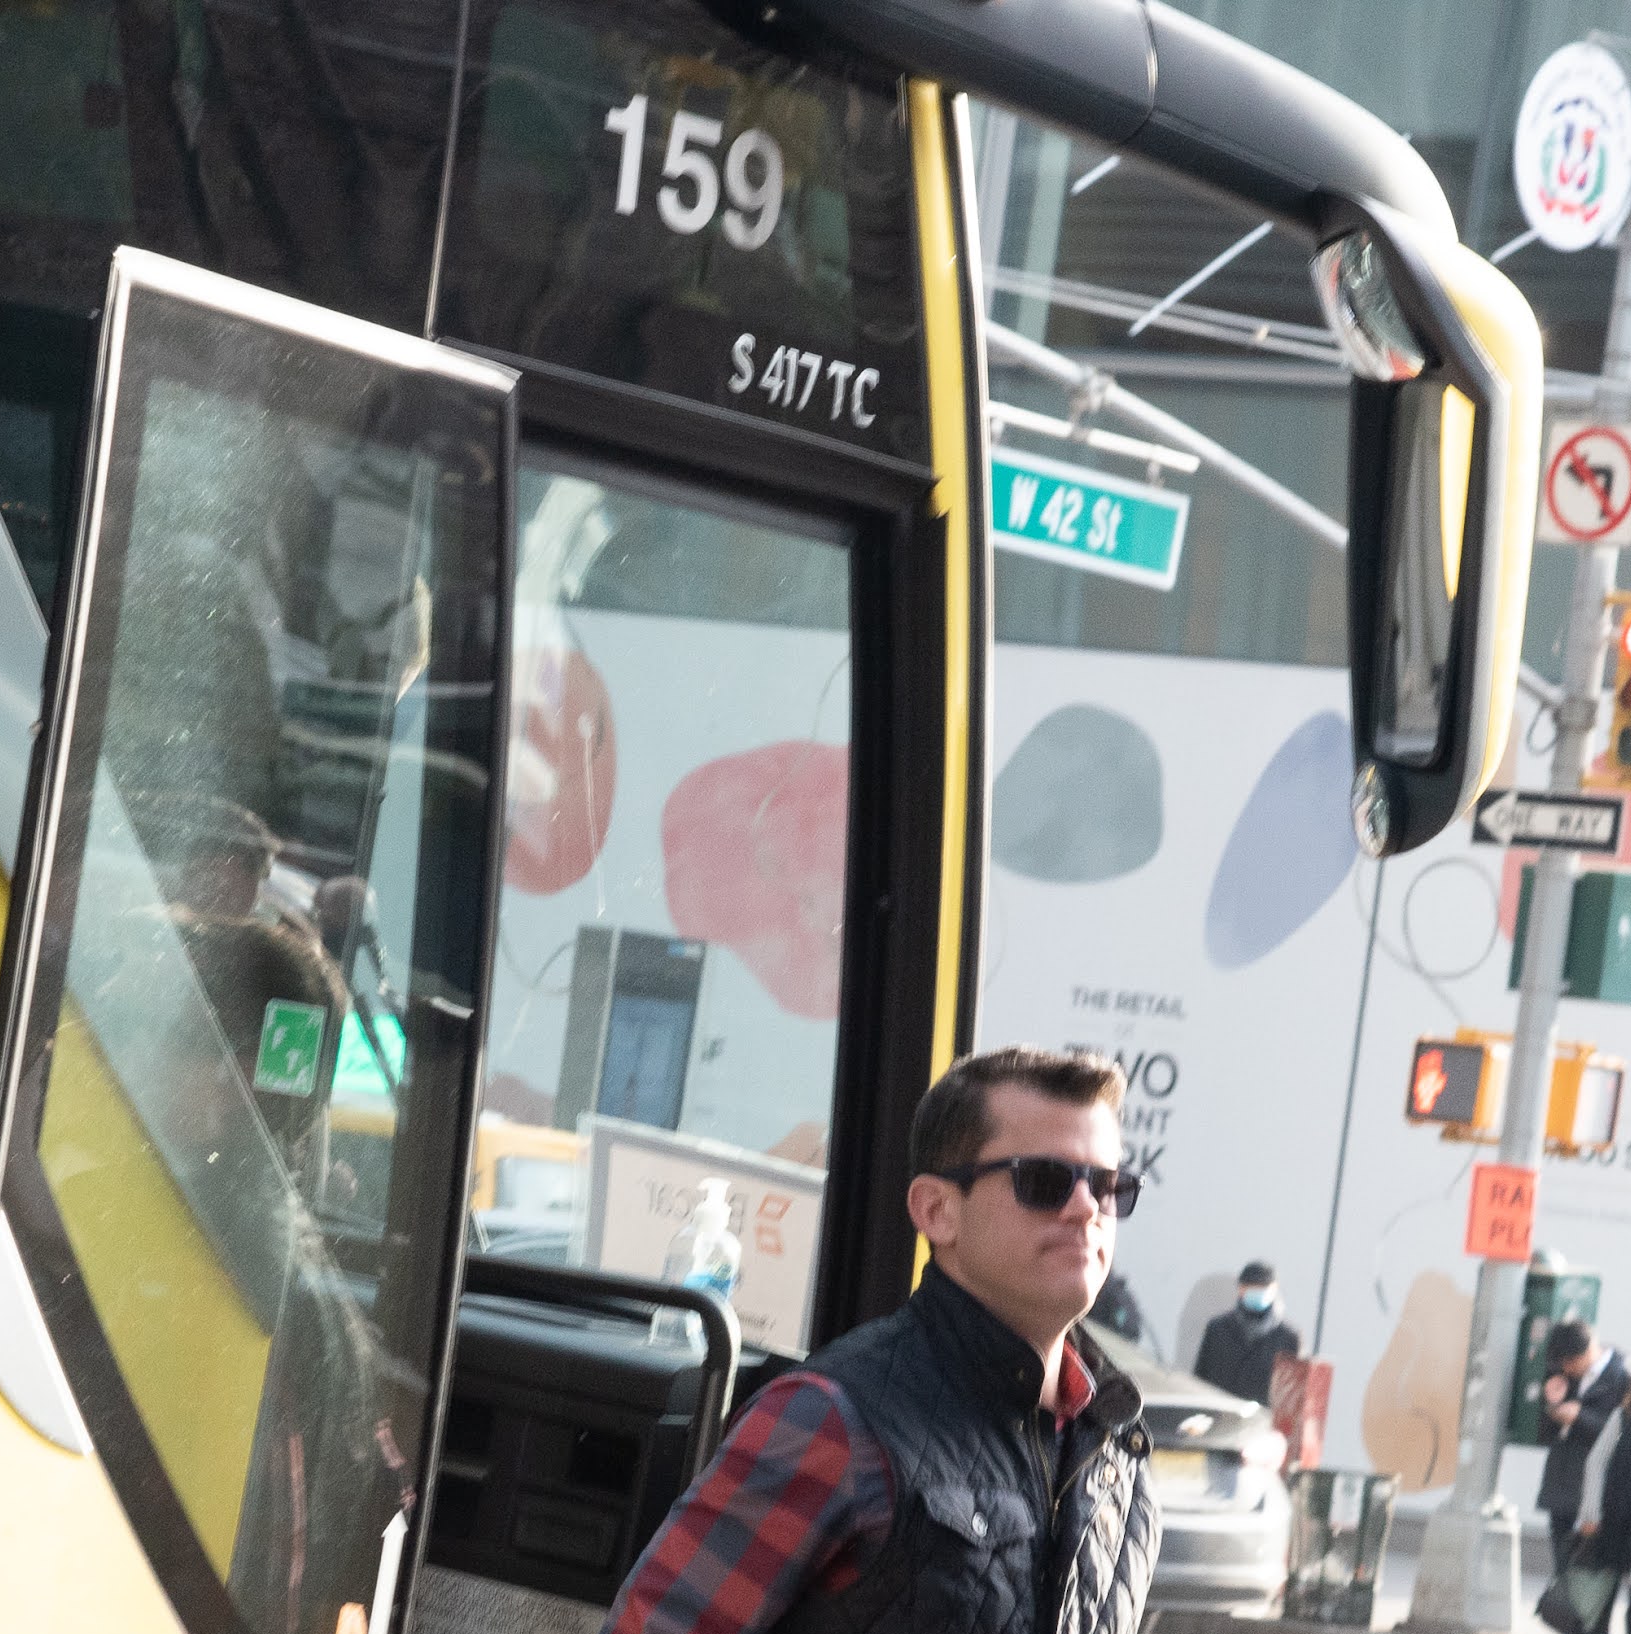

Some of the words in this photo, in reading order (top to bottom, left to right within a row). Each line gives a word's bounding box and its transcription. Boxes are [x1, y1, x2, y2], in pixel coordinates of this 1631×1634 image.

[604, 93, 784, 251] 159
[726, 332, 757, 394] S
[758, 344, 823, 412] 417
[826, 359, 881, 429] TC
[1008, 474, 1040, 531] W
[1039, 484, 1085, 544] 42
[1086, 496, 1124, 555] St
[1556, 807, 1604, 840] WAY
[1071, 986, 1110, 1011] THE
[1112, 991, 1186, 1020] RETAIL
